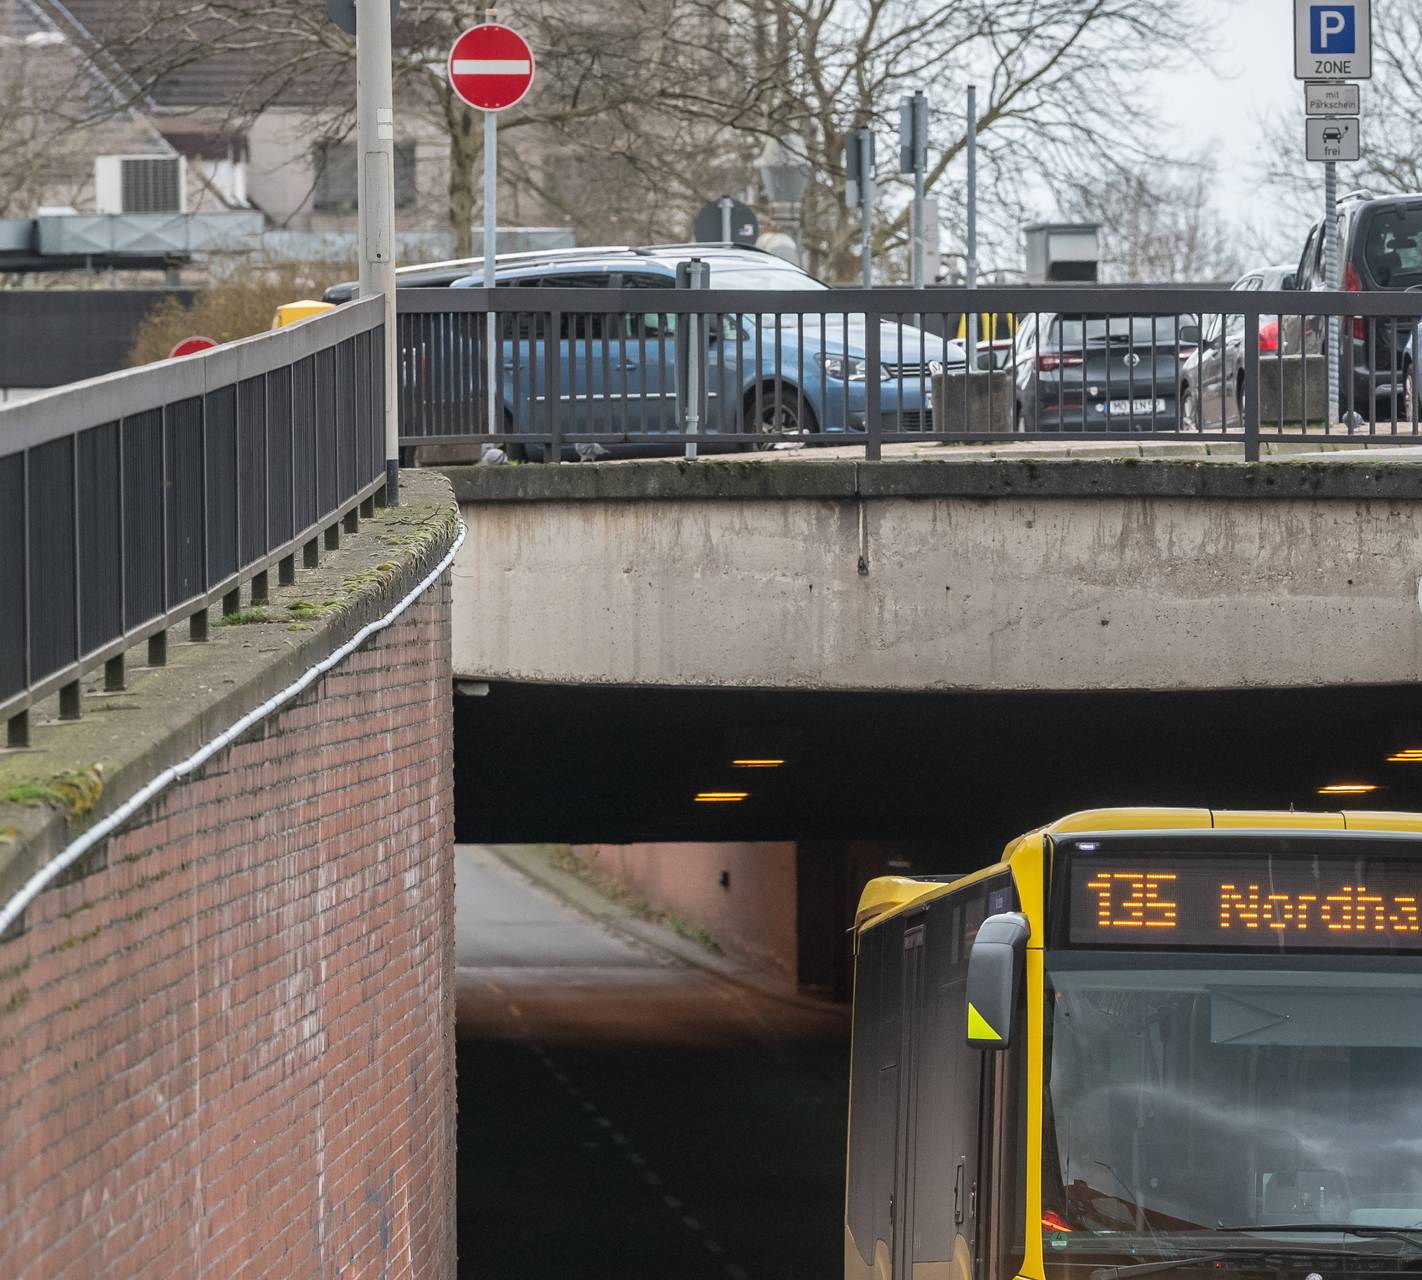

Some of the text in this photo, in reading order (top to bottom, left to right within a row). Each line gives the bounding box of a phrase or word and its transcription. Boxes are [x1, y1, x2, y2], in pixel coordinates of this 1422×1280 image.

[1320, 10, 1346, 48] P
[1315, 60, 1352, 74] ZONE
[1326, 91, 1340, 99] mit
[1310, 100, 1356, 109] Parkschein
[1325, 146, 1340, 156] frei
[1087, 873, 1177, 926] 135
